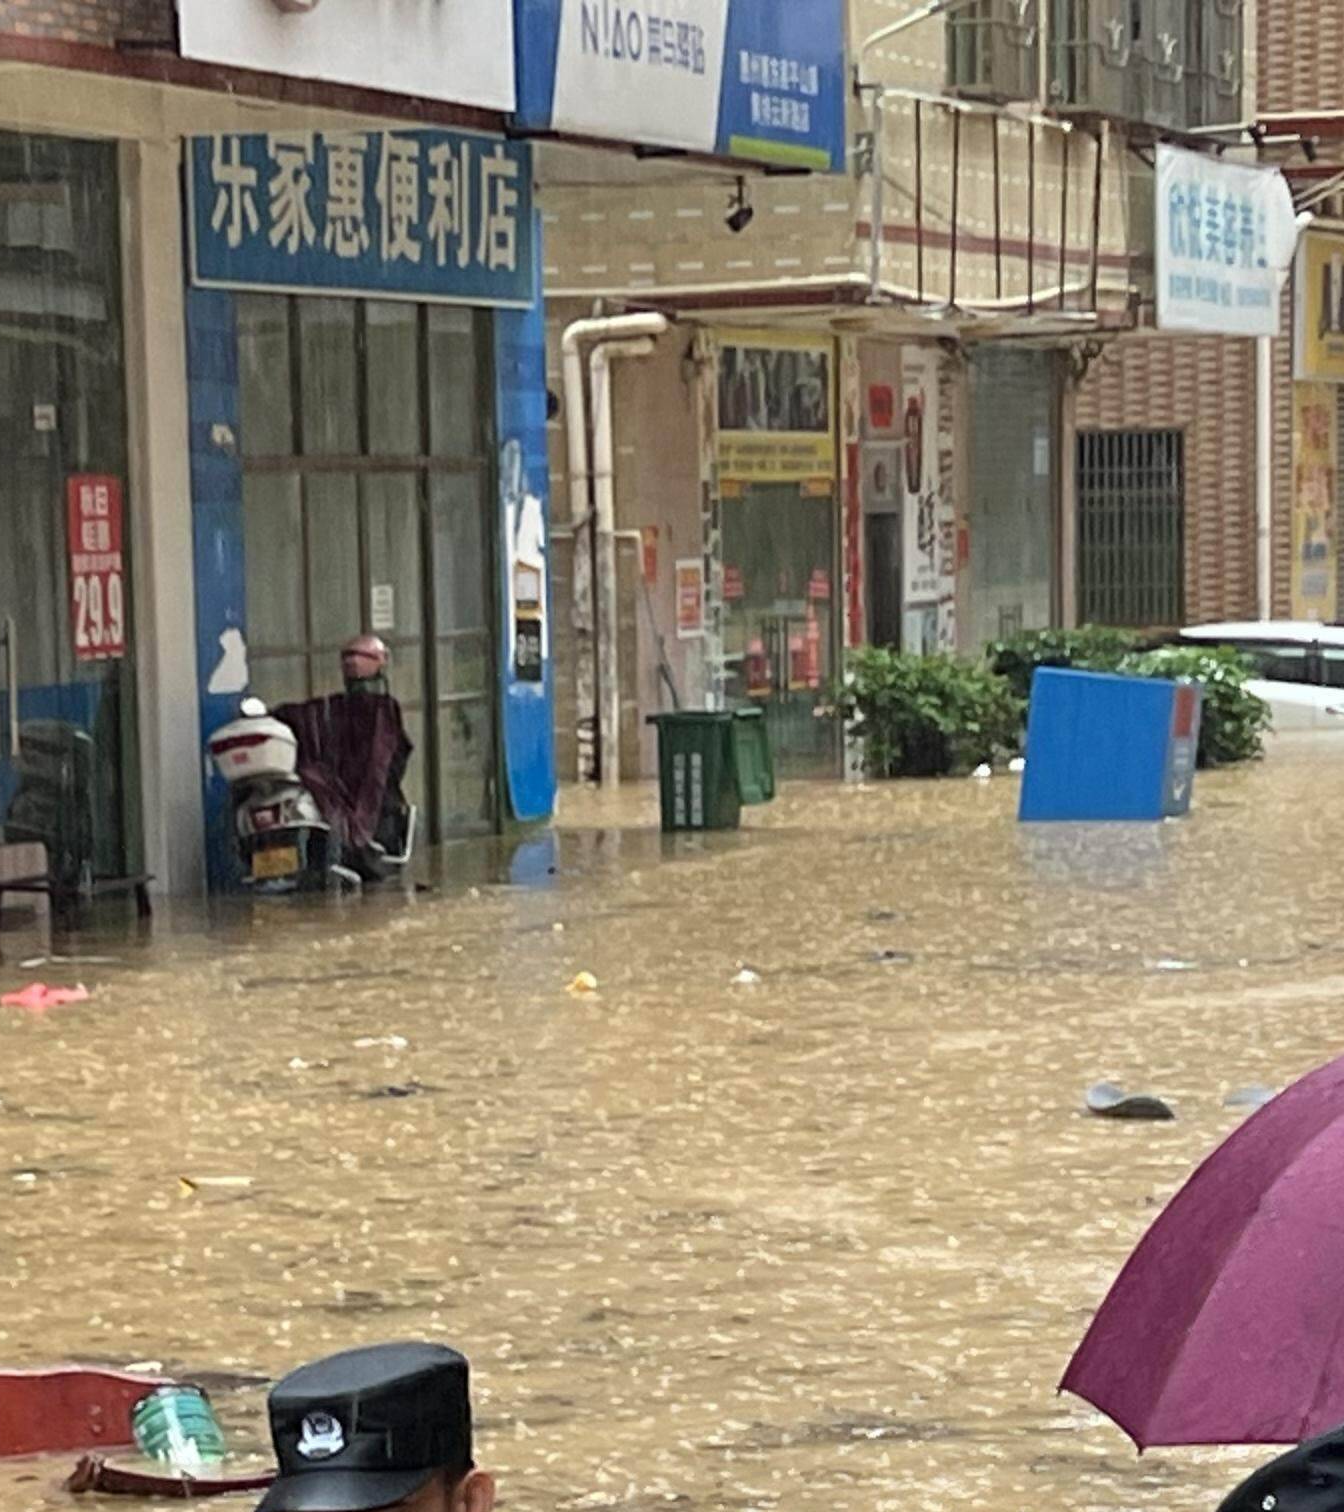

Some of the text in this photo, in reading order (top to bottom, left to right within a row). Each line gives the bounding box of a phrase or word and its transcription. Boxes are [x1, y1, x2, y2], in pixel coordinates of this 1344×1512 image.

[210, 132, 519, 273] 乐家惠便利店
[73, 574, 124, 648] 29.9
